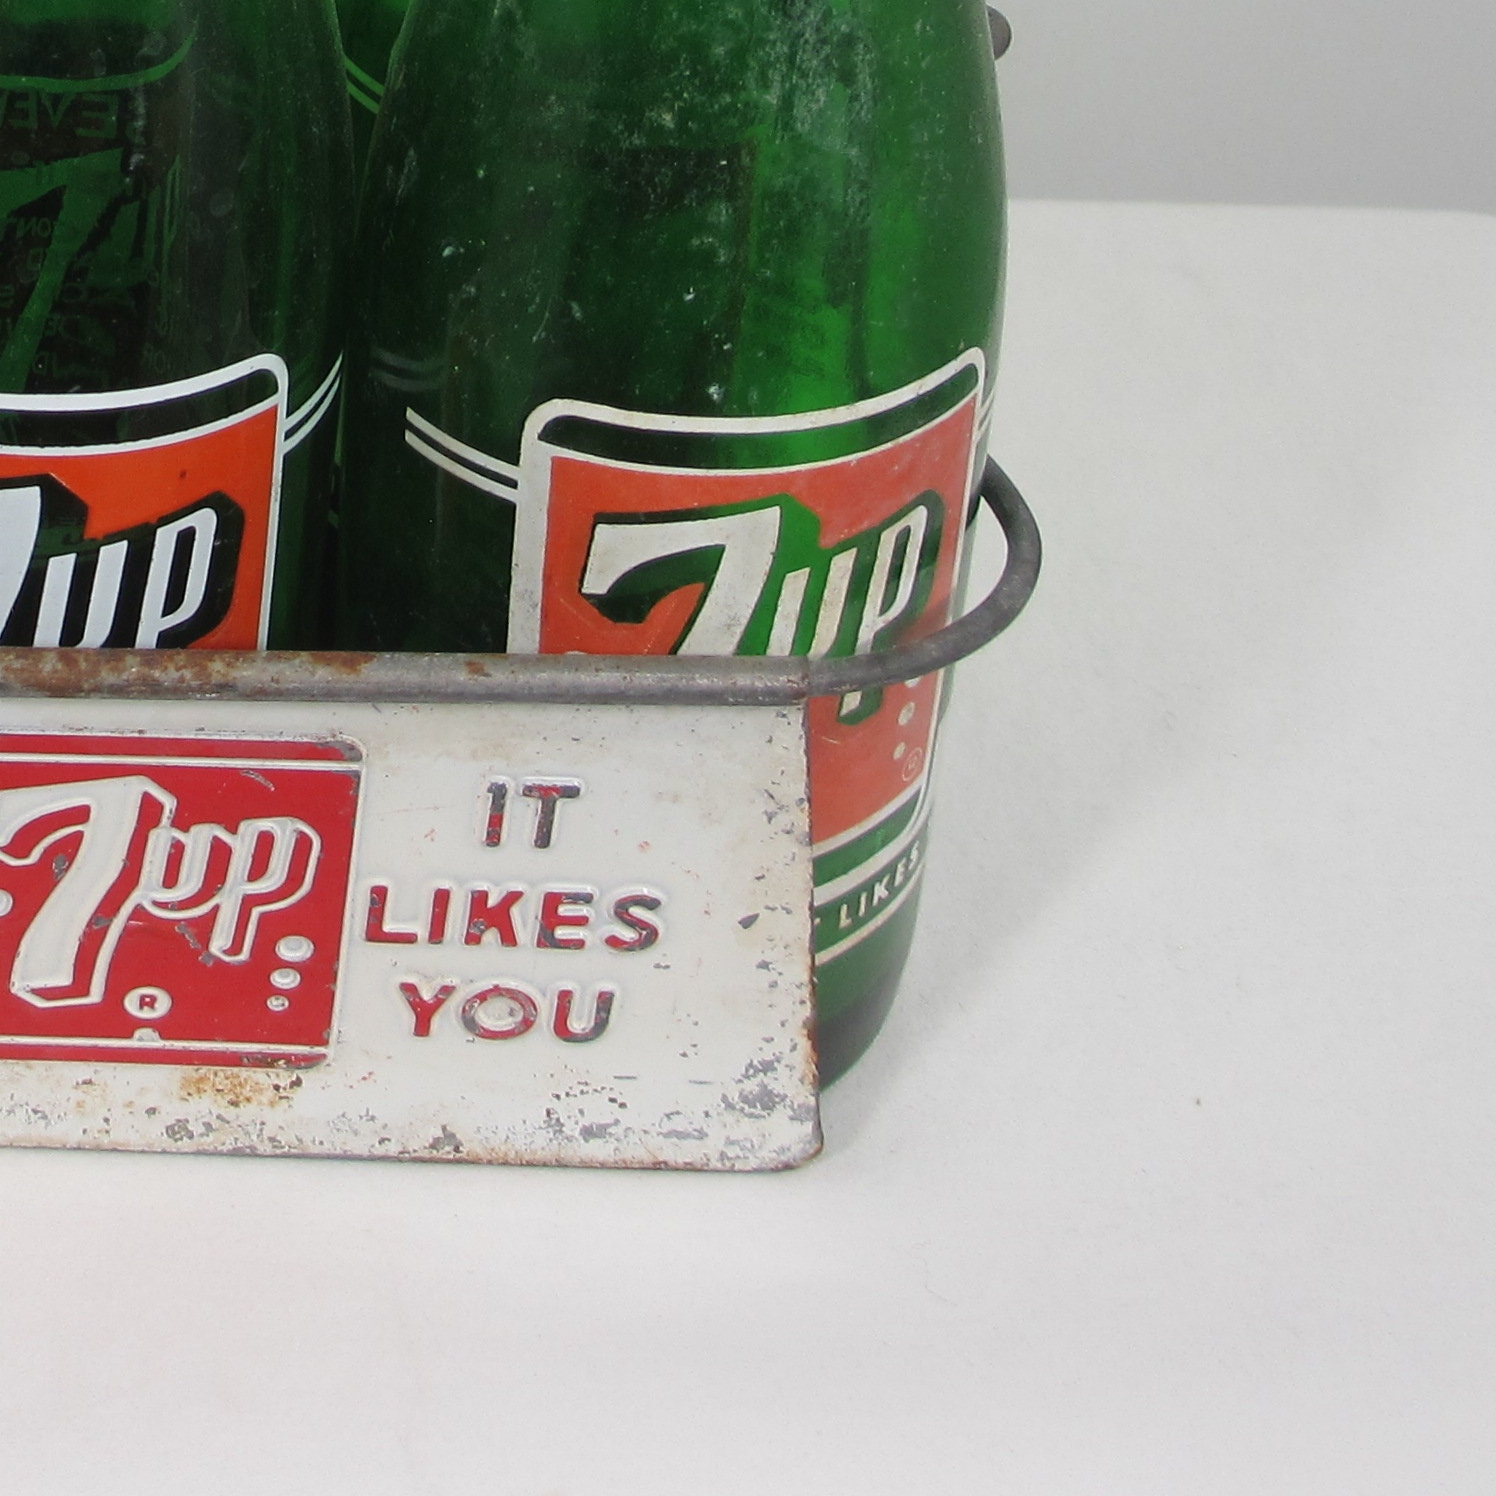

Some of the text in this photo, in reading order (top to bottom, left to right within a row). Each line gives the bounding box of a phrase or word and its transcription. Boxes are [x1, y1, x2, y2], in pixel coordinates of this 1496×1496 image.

[485, 782, 582, 850] IT
[365, 884, 662, 952] LIKES
[838, 840, 920, 930] LIKES
[399, 981, 615, 1044] YOU
